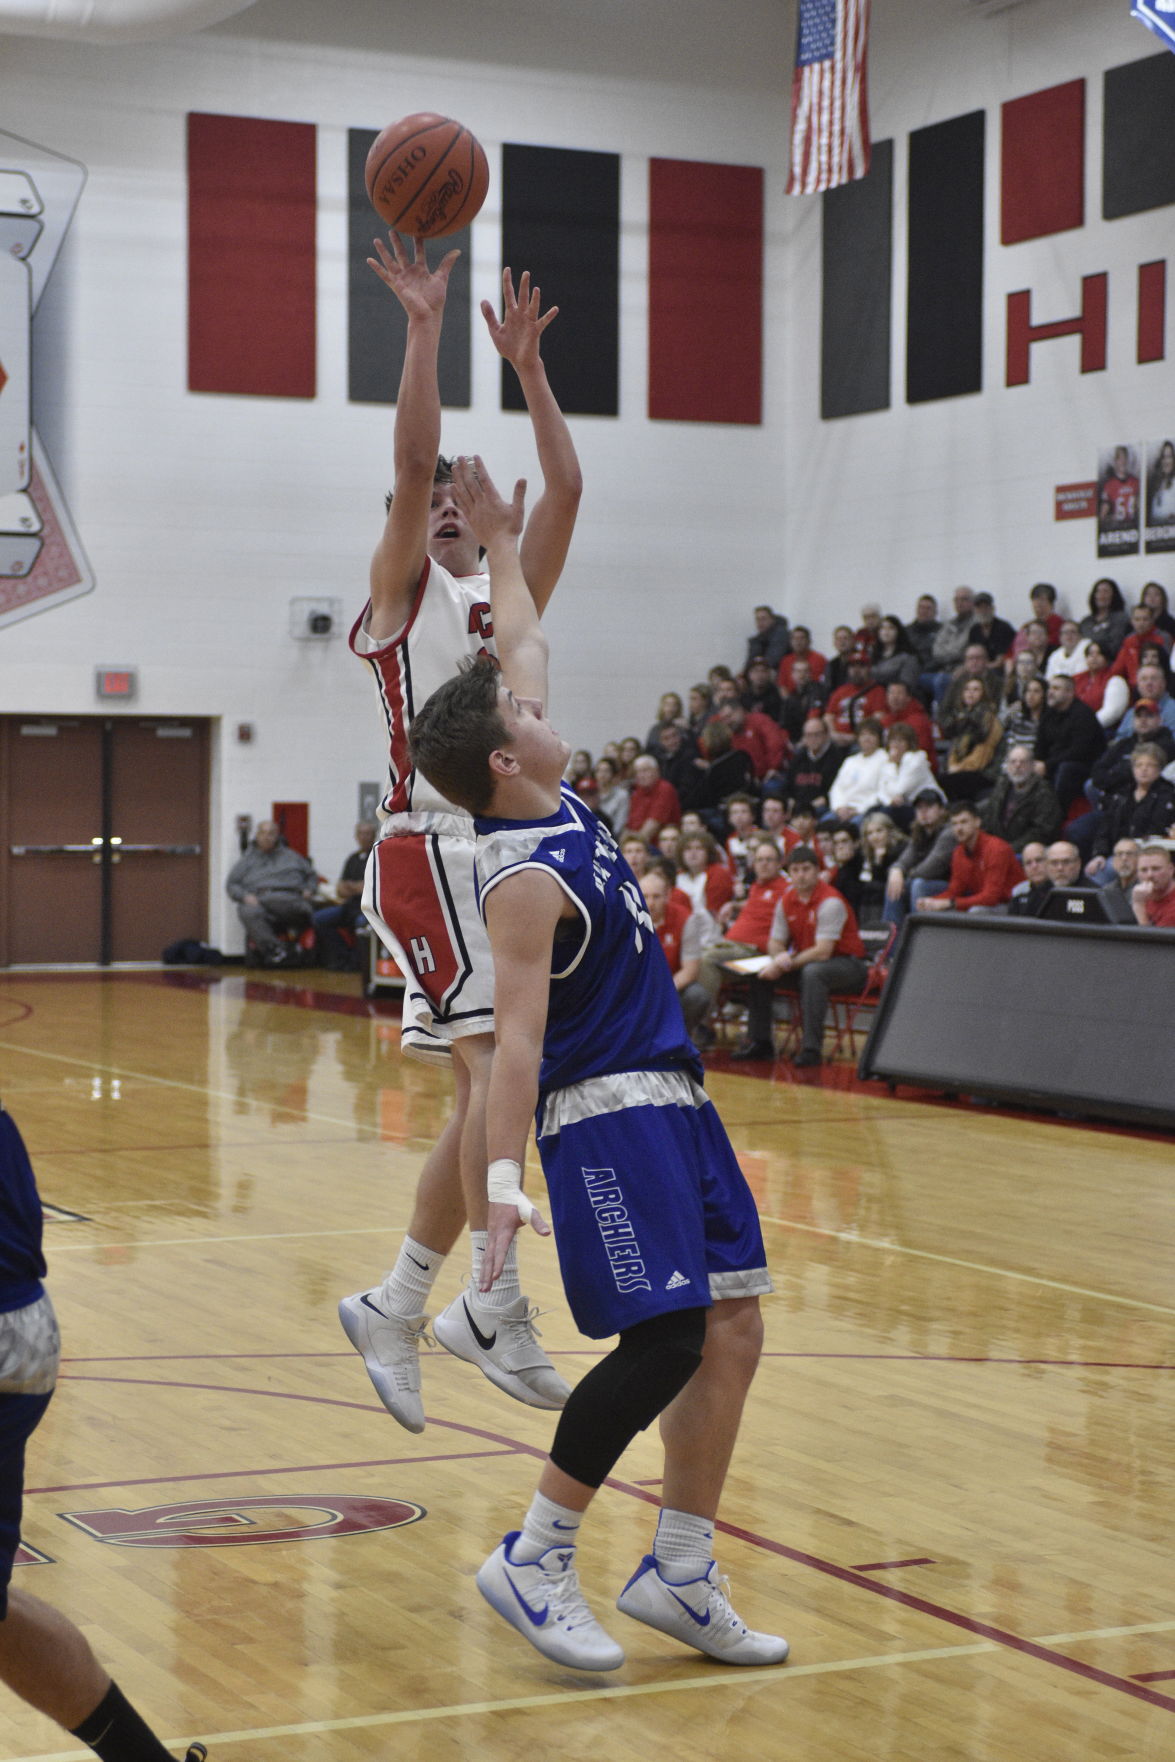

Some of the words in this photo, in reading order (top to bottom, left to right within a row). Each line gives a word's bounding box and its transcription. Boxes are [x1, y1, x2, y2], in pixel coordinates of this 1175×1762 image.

[378, 146, 427, 206] OHSAA
[1099, 529, 1139, 545] AREND
[409, 936, 437, 976] H
[581, 1166, 652, 1293] ARCHERS
